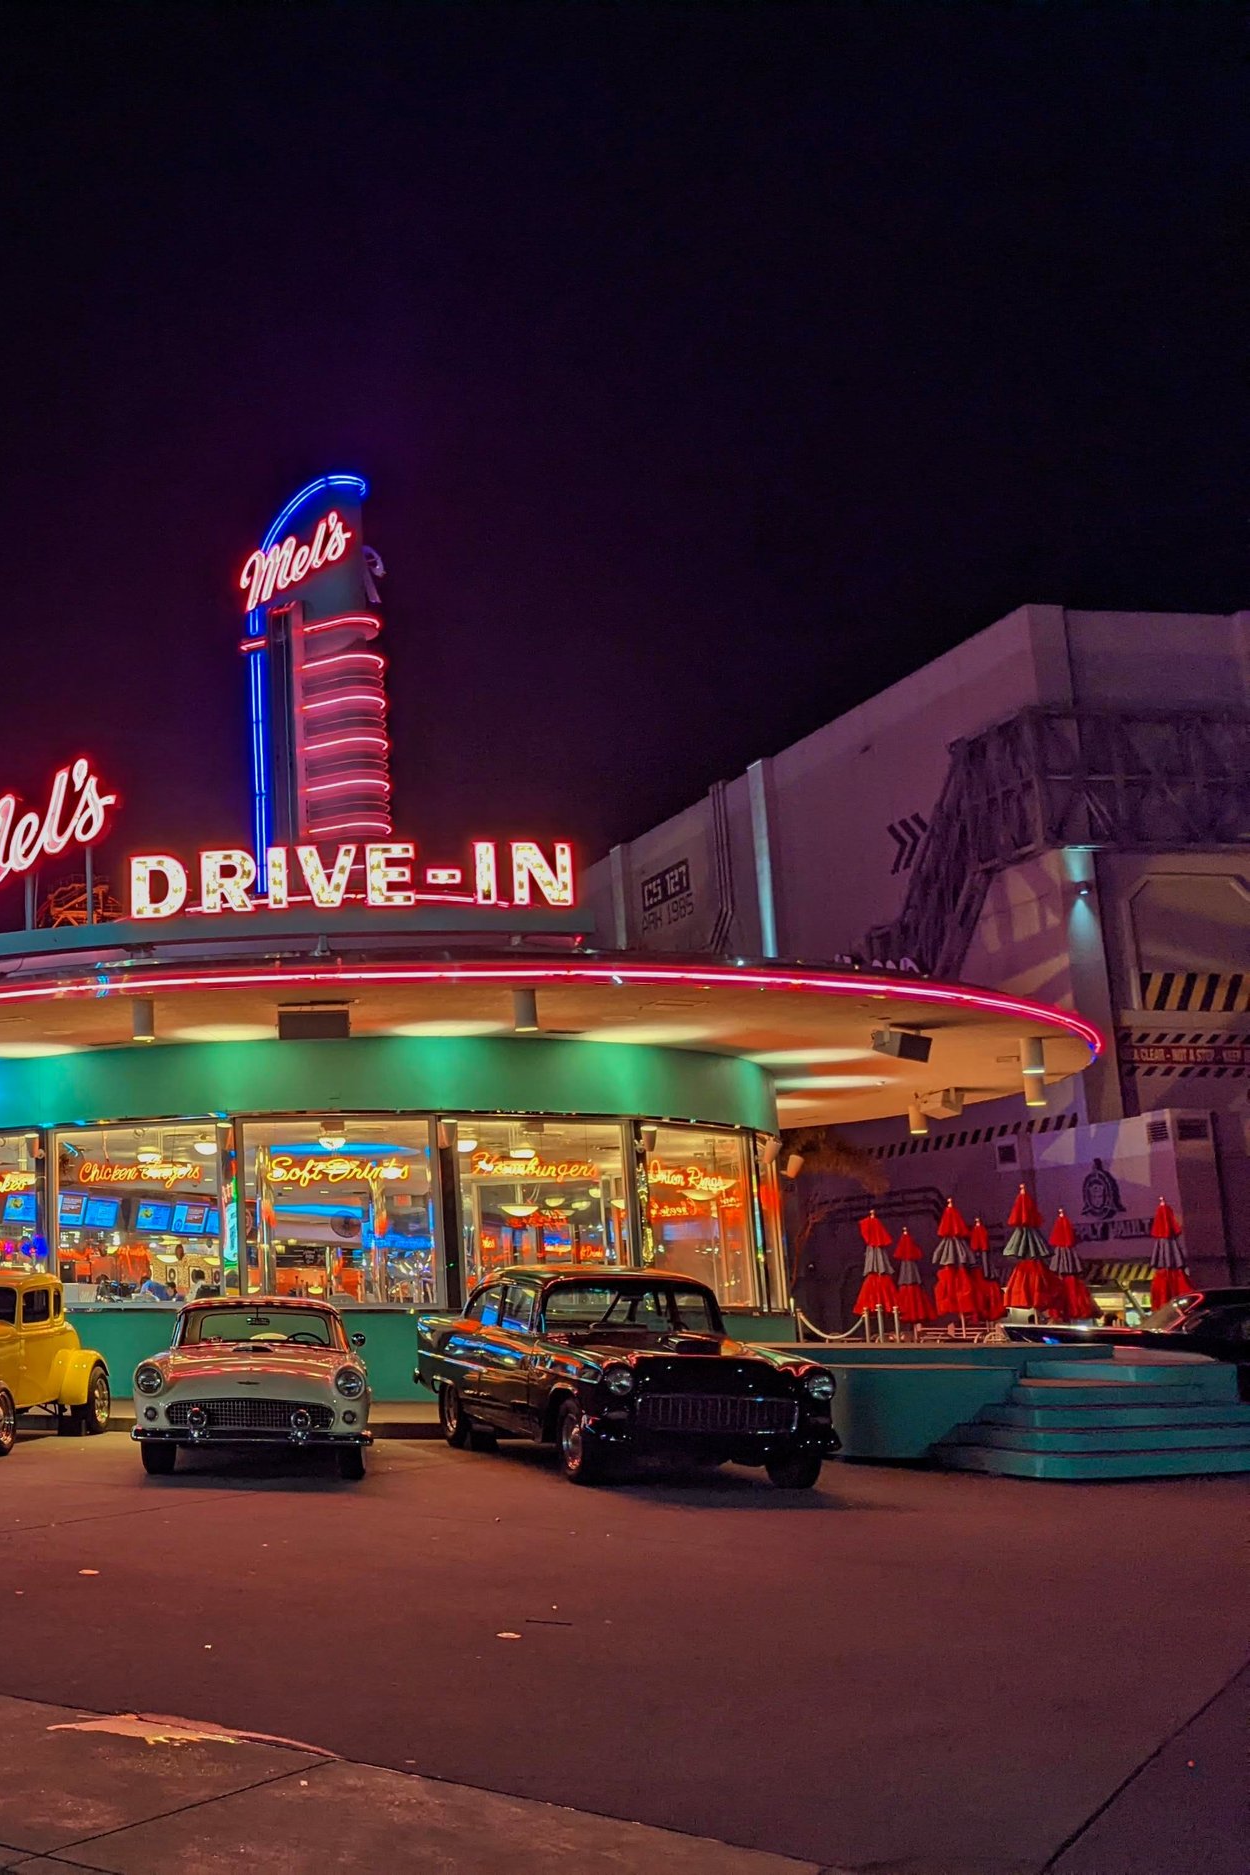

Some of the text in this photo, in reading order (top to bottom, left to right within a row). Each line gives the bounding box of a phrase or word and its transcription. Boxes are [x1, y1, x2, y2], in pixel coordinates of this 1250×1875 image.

[239, 510, 352, 612] Mel's
[129, 840, 574, 919] DRIVE-IN
[79, 1162, 137, 1183] Chicken
[267, 1157, 410, 1187] Soft Drinks
[648, 1160, 685, 1186] Onion
